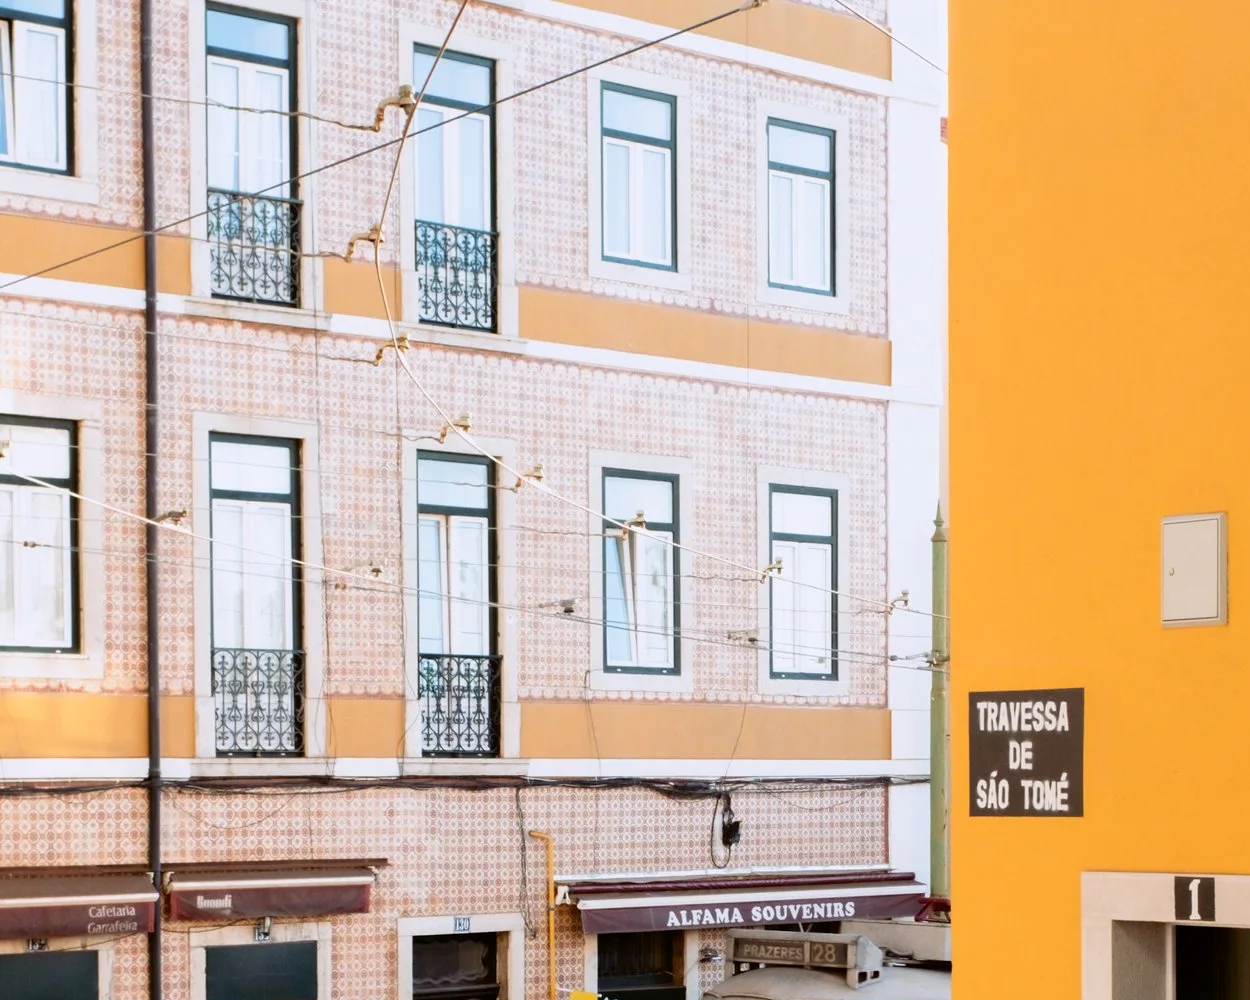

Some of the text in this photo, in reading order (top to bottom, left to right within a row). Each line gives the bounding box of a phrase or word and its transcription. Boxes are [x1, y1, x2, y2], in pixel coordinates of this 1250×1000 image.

[976, 701, 1069, 731] TRAVESSA
[1008, 740, 1033, 770] DE
[1020, 772, 1069, 811] TOMÉ
[1188, 878, 1201, 920] 1
[88, 905, 136, 918] Cafetaria
[667, 902, 855, 926] ALFAMA SOUVENIRS
[87, 920, 138, 934] Garrafeira
[455, 917, 469, 931] 130
[743, 943, 836, 963] PRAZERES 28
